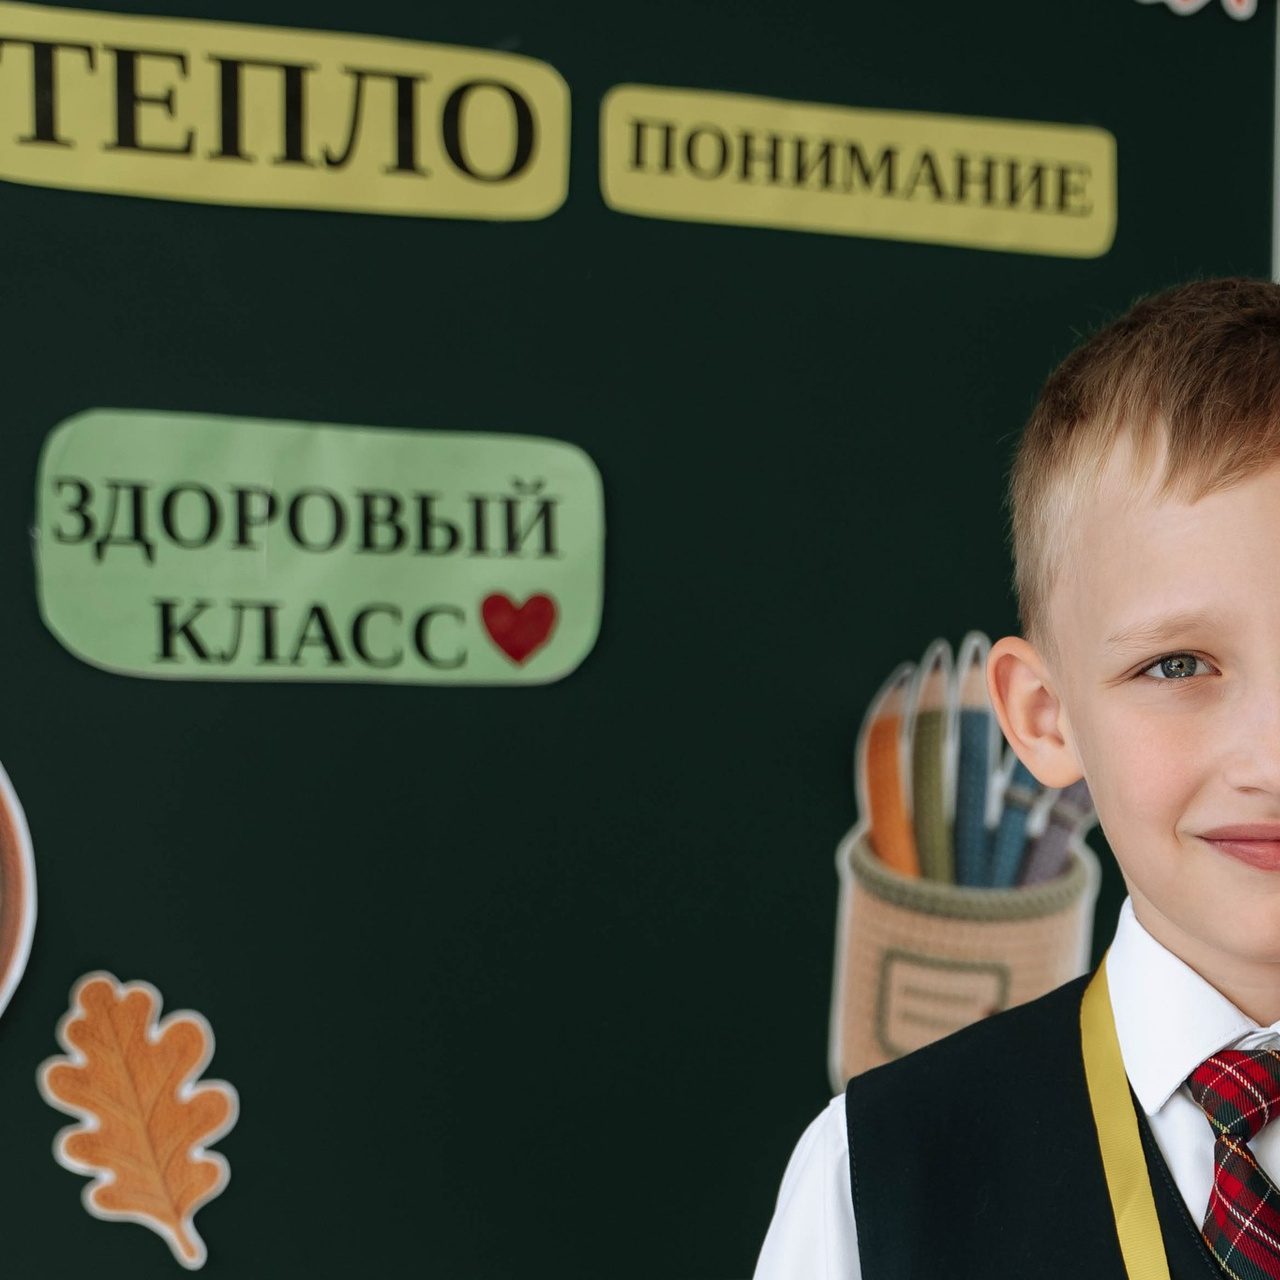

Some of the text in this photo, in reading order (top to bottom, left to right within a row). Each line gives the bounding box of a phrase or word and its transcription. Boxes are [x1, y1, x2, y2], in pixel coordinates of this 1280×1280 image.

[0, 36, 540, 186] ТЕПЛО
[626, 117, 1095, 219] ПОНИМАНИЕ
[52, 476, 563, 565] ЗДОРОВЫЙ
[152, 598, 469, 669] КЛАСС
